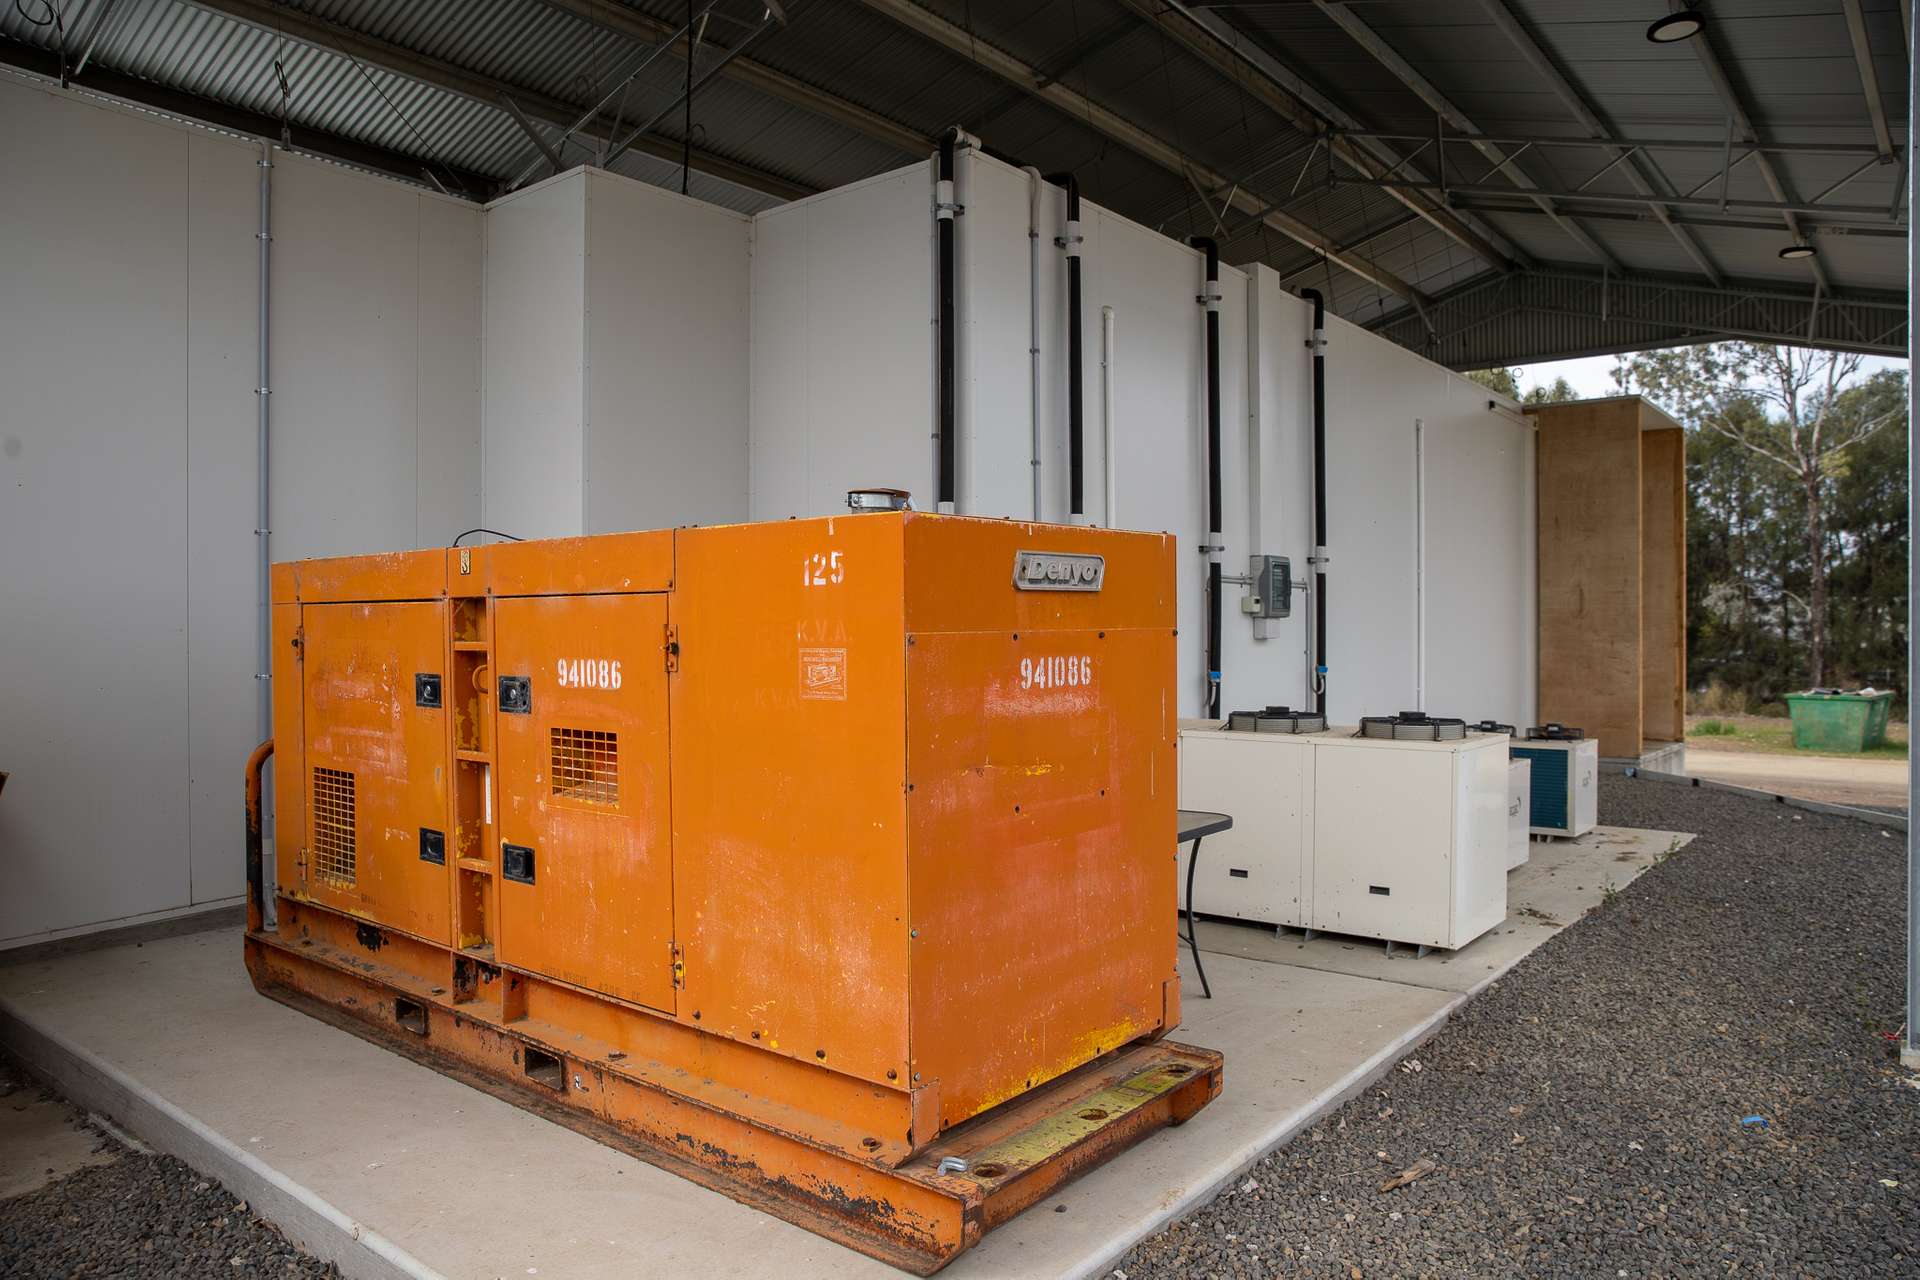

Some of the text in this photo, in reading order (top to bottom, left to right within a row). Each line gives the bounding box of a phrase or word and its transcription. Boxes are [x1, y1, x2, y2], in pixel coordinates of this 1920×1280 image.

[804, 551, 845, 586] 125
[1027, 558, 1096, 586] Denyo
[557, 658, 622, 689] 941086
[1020, 655, 1092, 689] 941086
